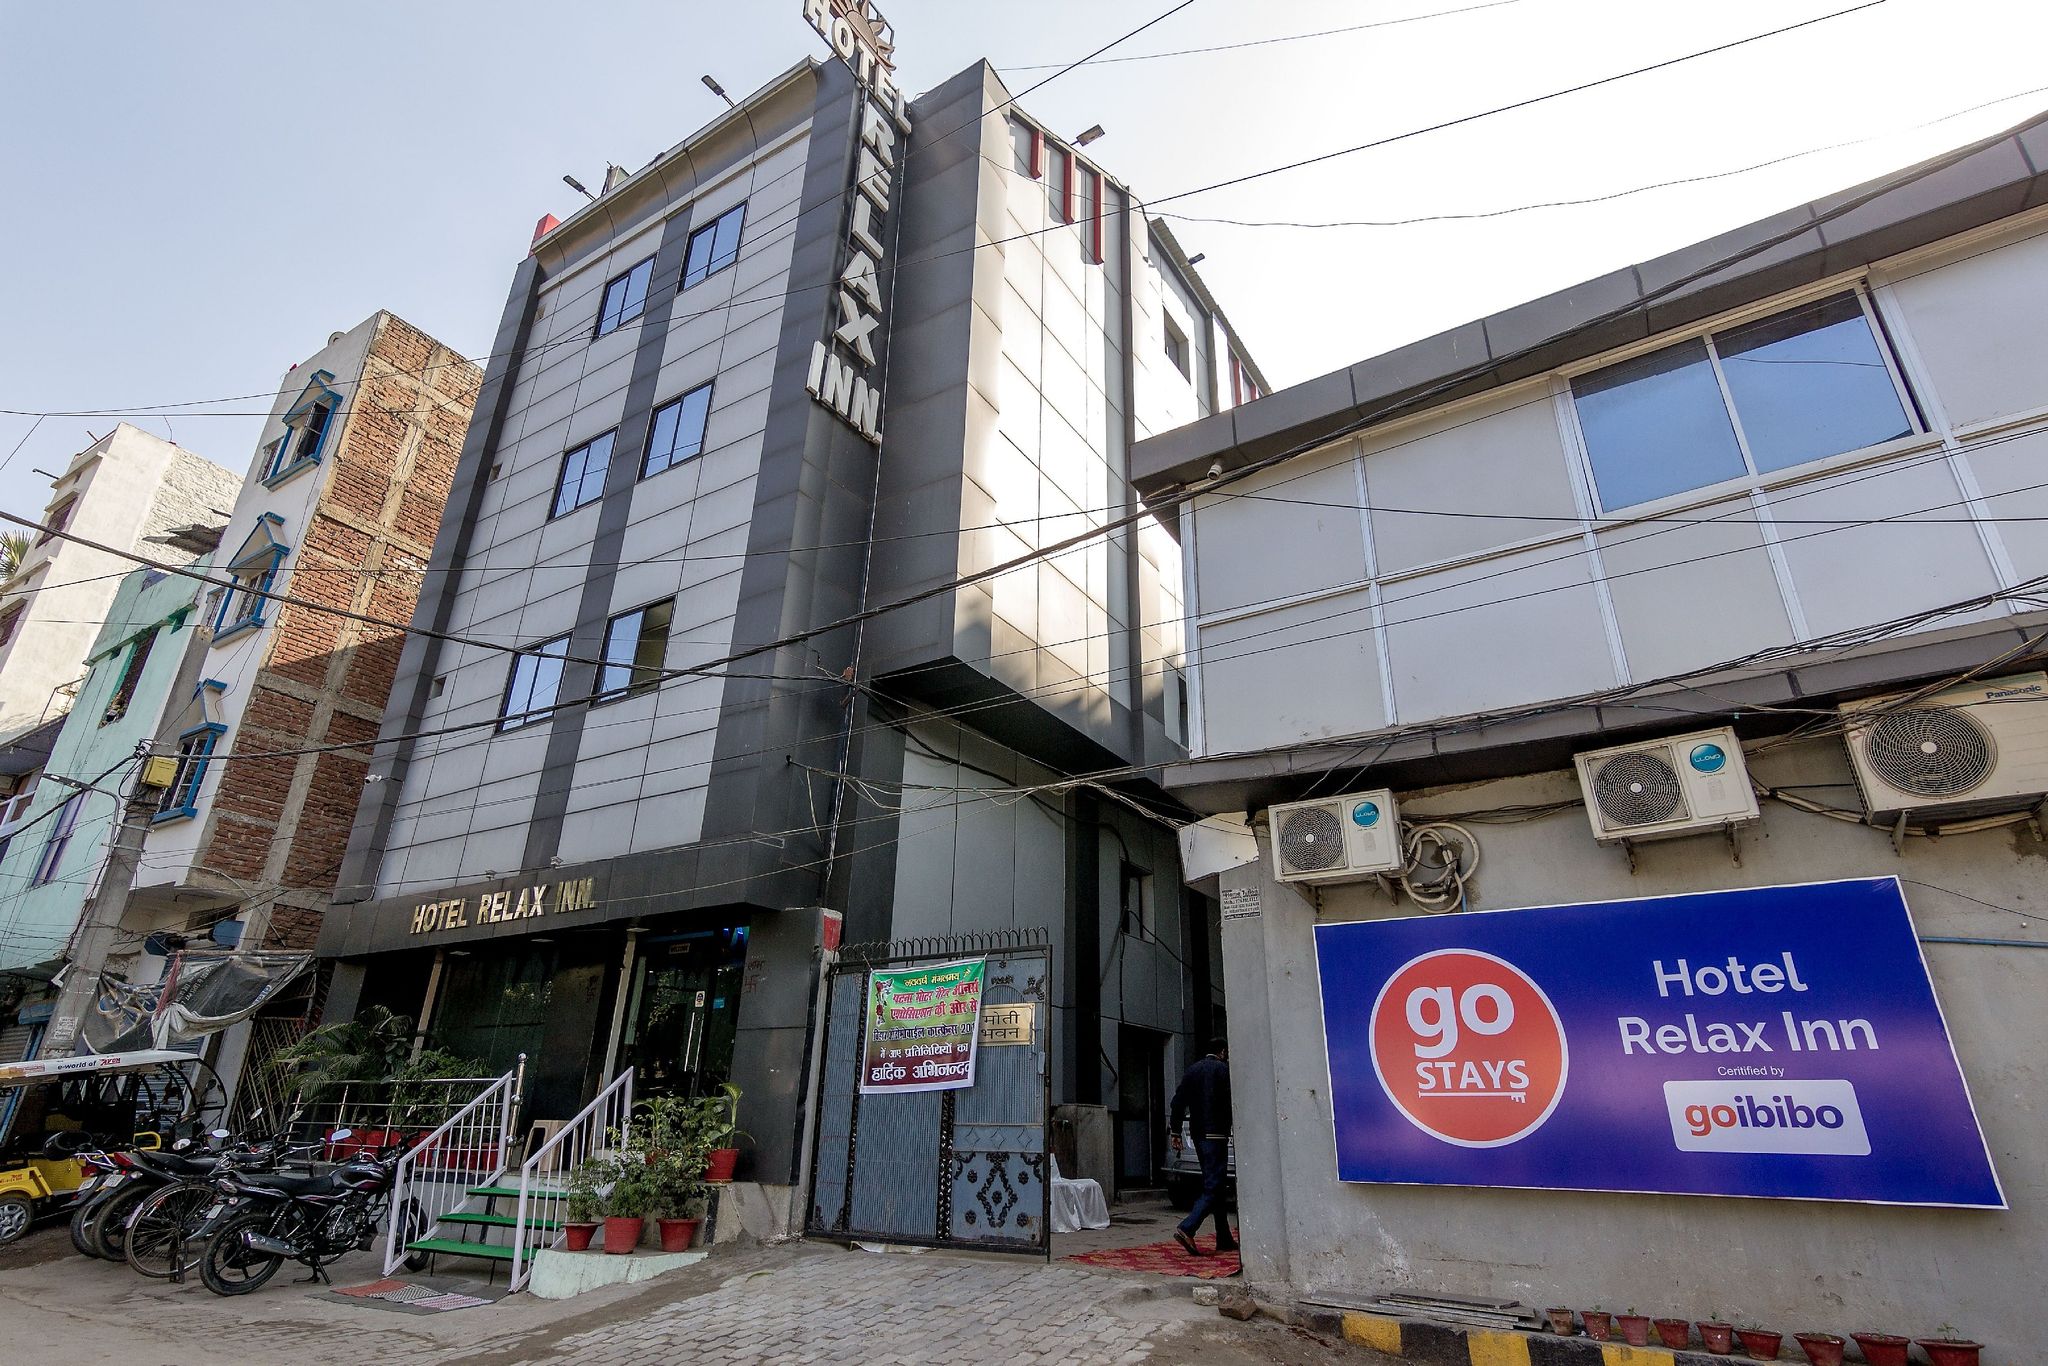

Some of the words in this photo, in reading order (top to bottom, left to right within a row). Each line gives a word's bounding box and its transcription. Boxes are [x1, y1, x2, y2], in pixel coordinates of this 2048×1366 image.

[804, 0, 912, 135] HOTEL
[834, 101, 896, 368] RELAX
[1985, 684, 2042, 699] Panasonic
[410, 897, 468, 934] HOTEL
[476, 883, 548, 925] RELAX
[1652, 951, 1809, 998] Hotel
[934, 1001, 947, 1017] की
[983, 1010, 1020, 1025] मोती
[1405, 983, 1515, 1059] go
[981, 1027, 1020, 1040] भवन
[1617, 1013, 1774, 1055] Relax
[1782, 1011, 1880, 1052] Inn
[904, 1042, 953, 1058] प्रतिनिधियों
[957, 1043, 969, 1053] का
[57, 1062, 86, 1070] e-world
[871, 1061, 907, 1082] हार्दिक
[1416, 1060, 1530, 1090] STAYS
[1717, 1065, 1768, 1076] Ceritified
[1770, 1065, 1785, 1078] by
[1684, 1095, 1844, 1137] goibibo
